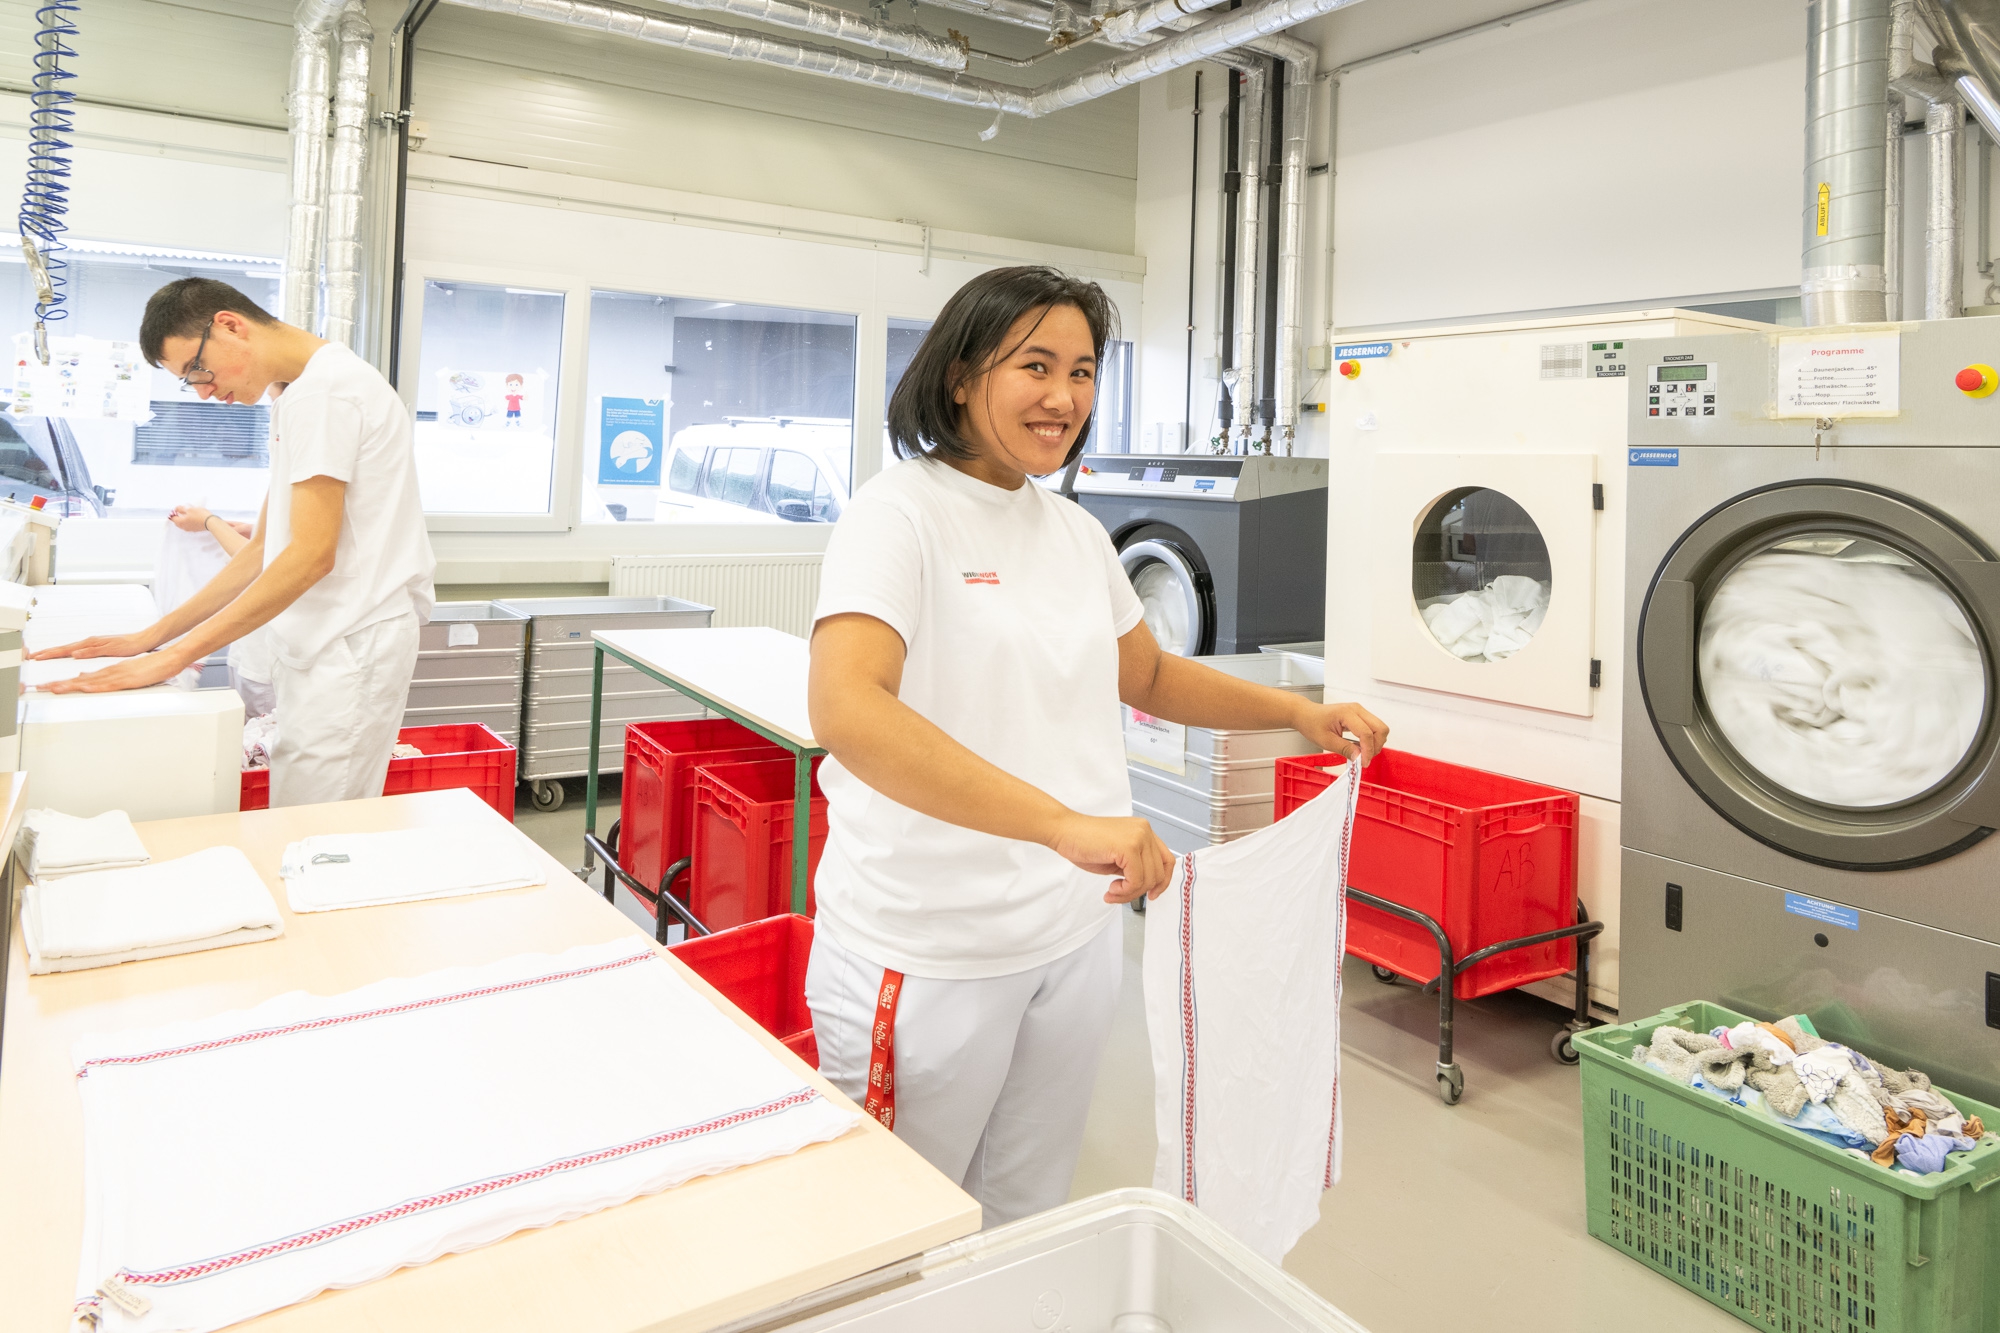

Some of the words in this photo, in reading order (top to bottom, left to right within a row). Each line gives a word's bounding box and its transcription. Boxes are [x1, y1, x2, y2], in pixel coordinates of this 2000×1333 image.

[1338, 345, 1390, 358] JESSERNIGG
[1811, 348, 1864, 357] Programme
[1493, 842, 1536, 893] AB
[1806, 899, 1836, 911] ACHTUNG!
